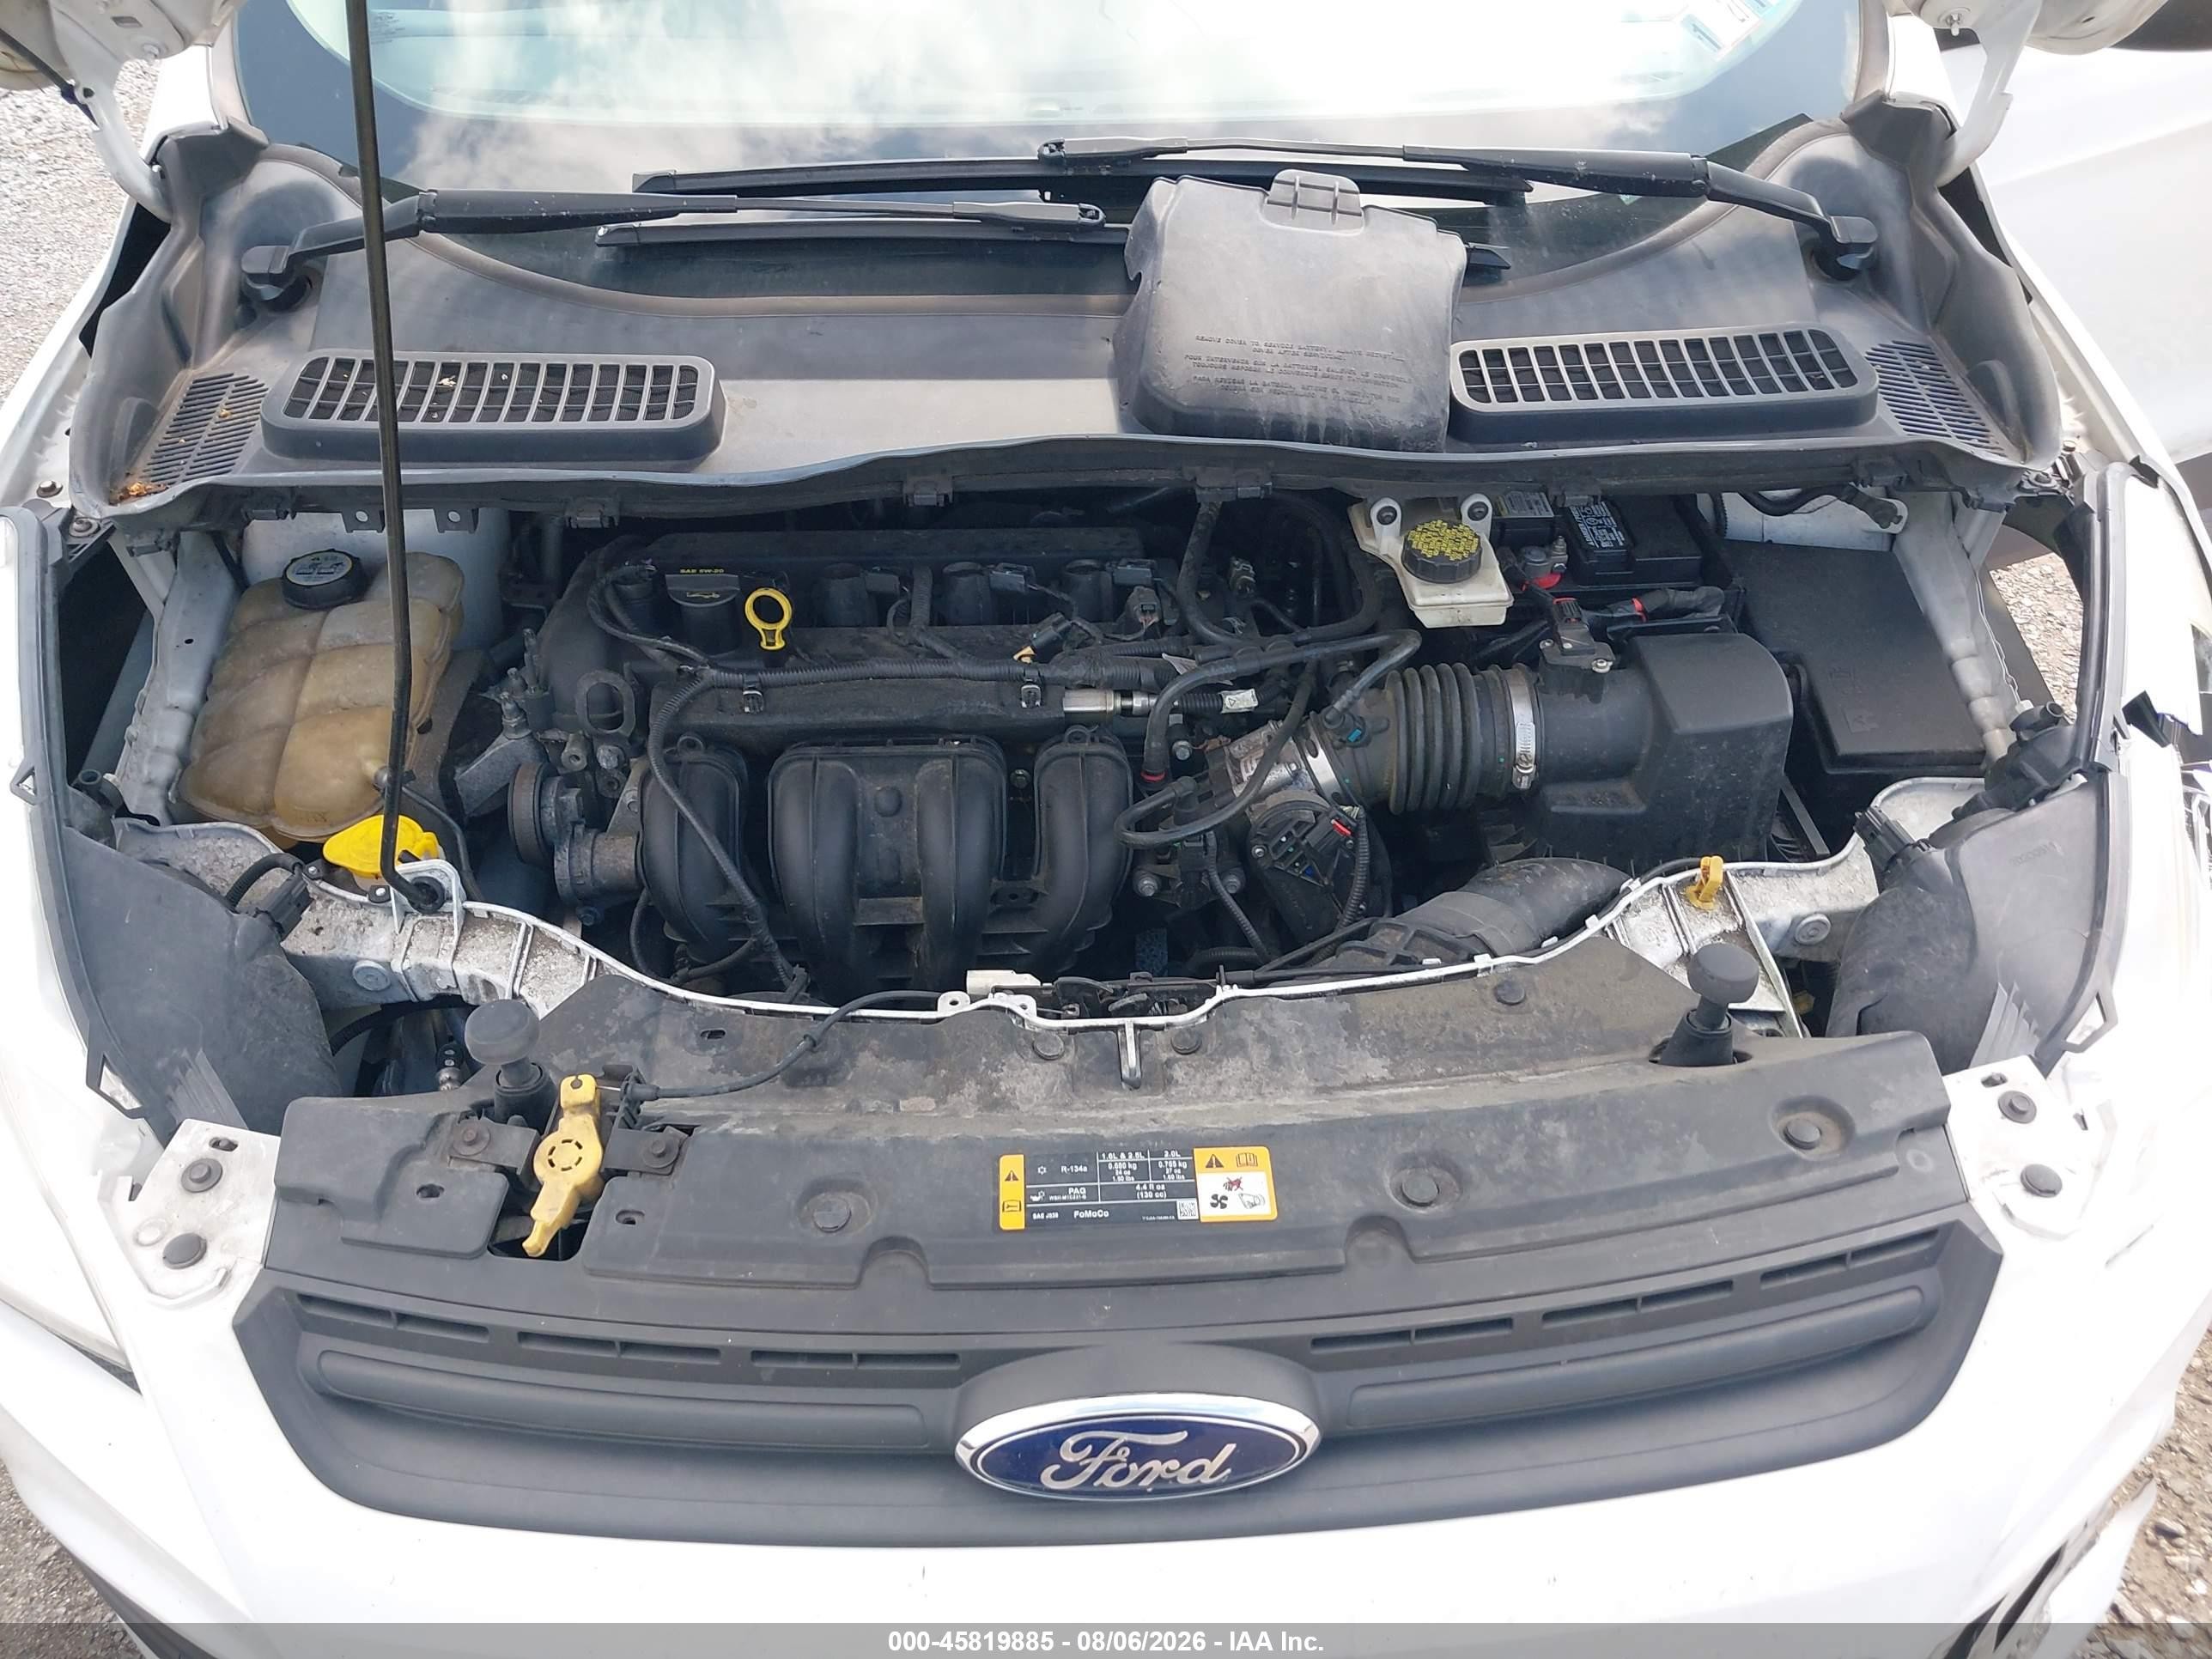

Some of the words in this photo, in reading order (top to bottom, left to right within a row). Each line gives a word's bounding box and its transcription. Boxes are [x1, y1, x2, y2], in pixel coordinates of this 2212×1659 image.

[1060, 1164, 1087, 1173] R-134a
[1128, 1162, 1137, 1170] kg
[1178, 1160, 1187, 1169] kg
[1068, 1187, 1087, 1195] PAG
[1073, 1209, 1109, 1218] FoMoCo
[1040, 1430, 1237, 1490] Ford
